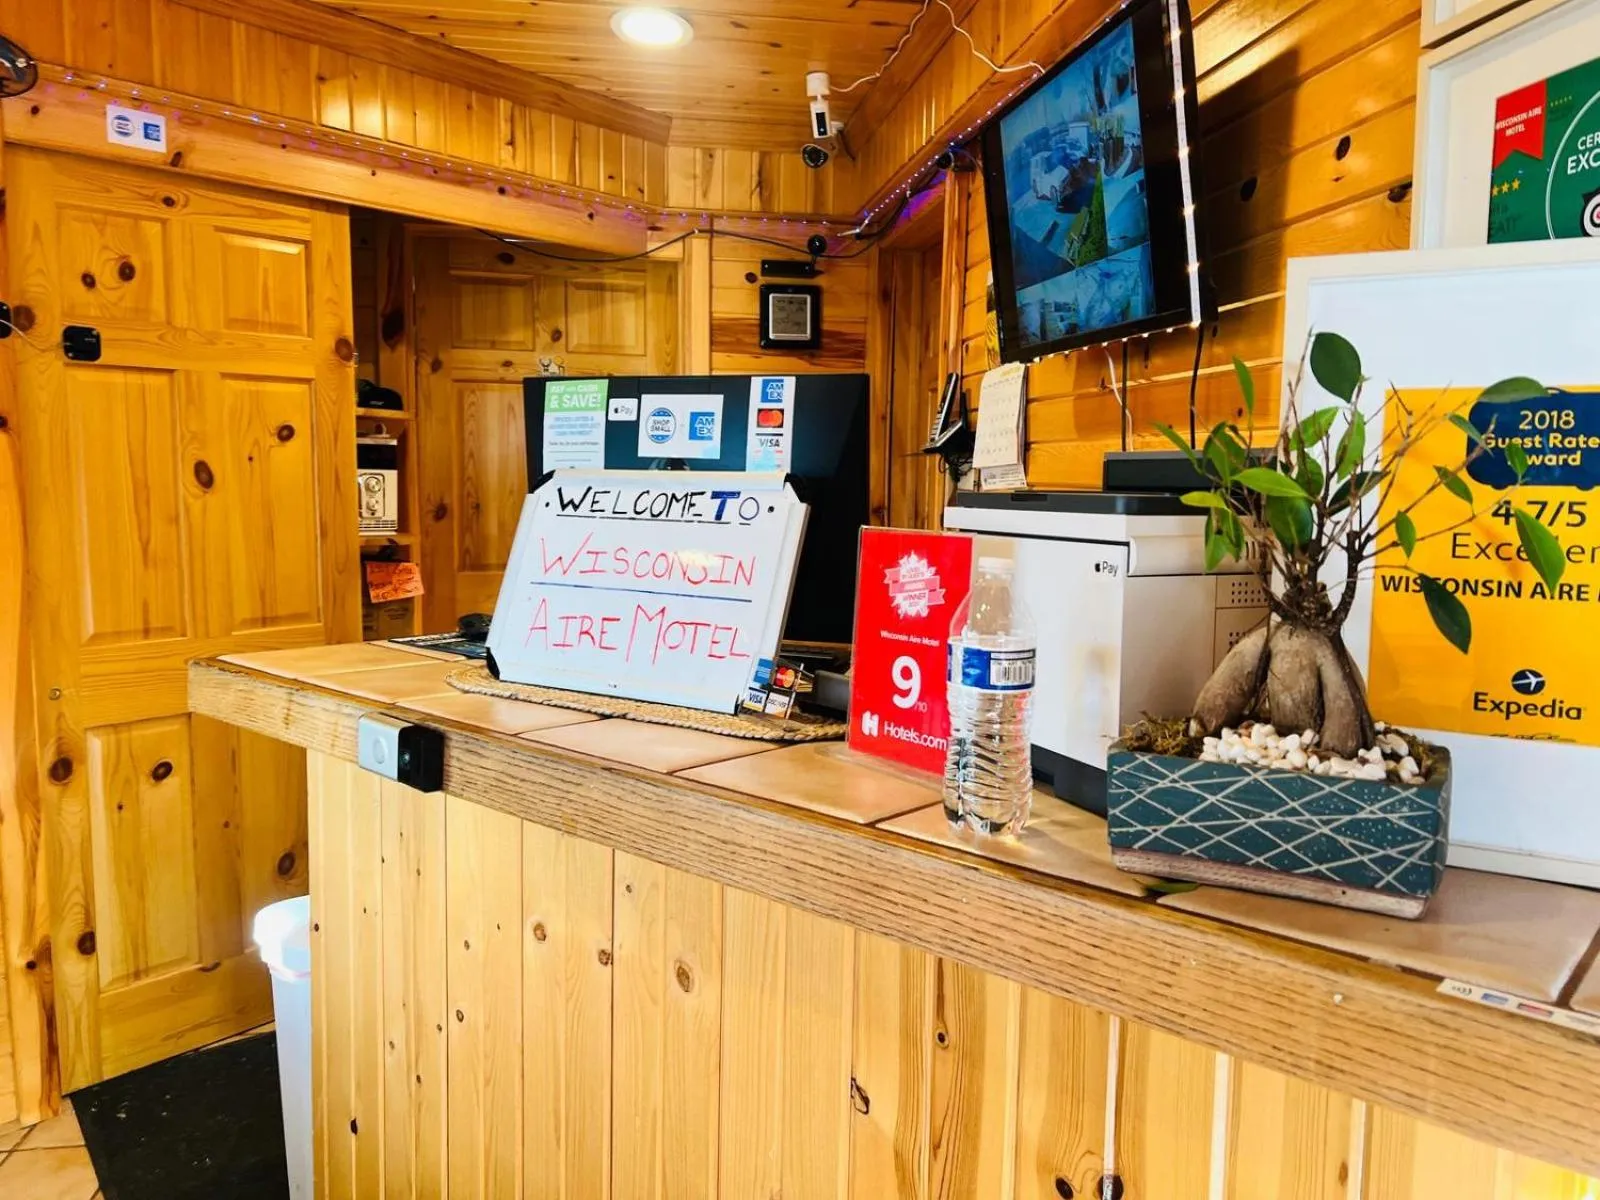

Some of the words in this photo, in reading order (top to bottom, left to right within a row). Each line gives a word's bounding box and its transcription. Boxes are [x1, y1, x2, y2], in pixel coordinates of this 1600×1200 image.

[1567, 147, 1600, 176] EXC
[768, 383, 784, 391] AM
[562, 393, 601, 408] SAVE!
[770, 391, 783, 400] EX
[620, 406, 634, 416] Pay
[697, 417, 714, 426] AM
[1519, 410, 1576, 430] 2018
[650, 425, 671, 433] SMALL
[698, 426, 713, 436] EX
[759, 438, 780, 448] VISA
[1507, 450, 1582, 466] ward
[556, 486, 706, 518] WELCOME
[710, 490, 760, 521] TO
[540, 531, 757, 587] WISCONSIN
[1102, 560, 1119, 577] Pay
[1381, 574, 1523, 599] WISONSIN
[1529, 582, 1591, 602] ARE
[524, 597, 621, 651] AIRE
[624, 603, 750, 666] MOTEL
[880, 629, 909, 642] Wisconsin
[891, 655, 922, 709] 9
[749, 692, 763, 705] VISA
[1472, 691, 1583, 720] Expedia
[884, 721, 948, 751] Hotels.com
